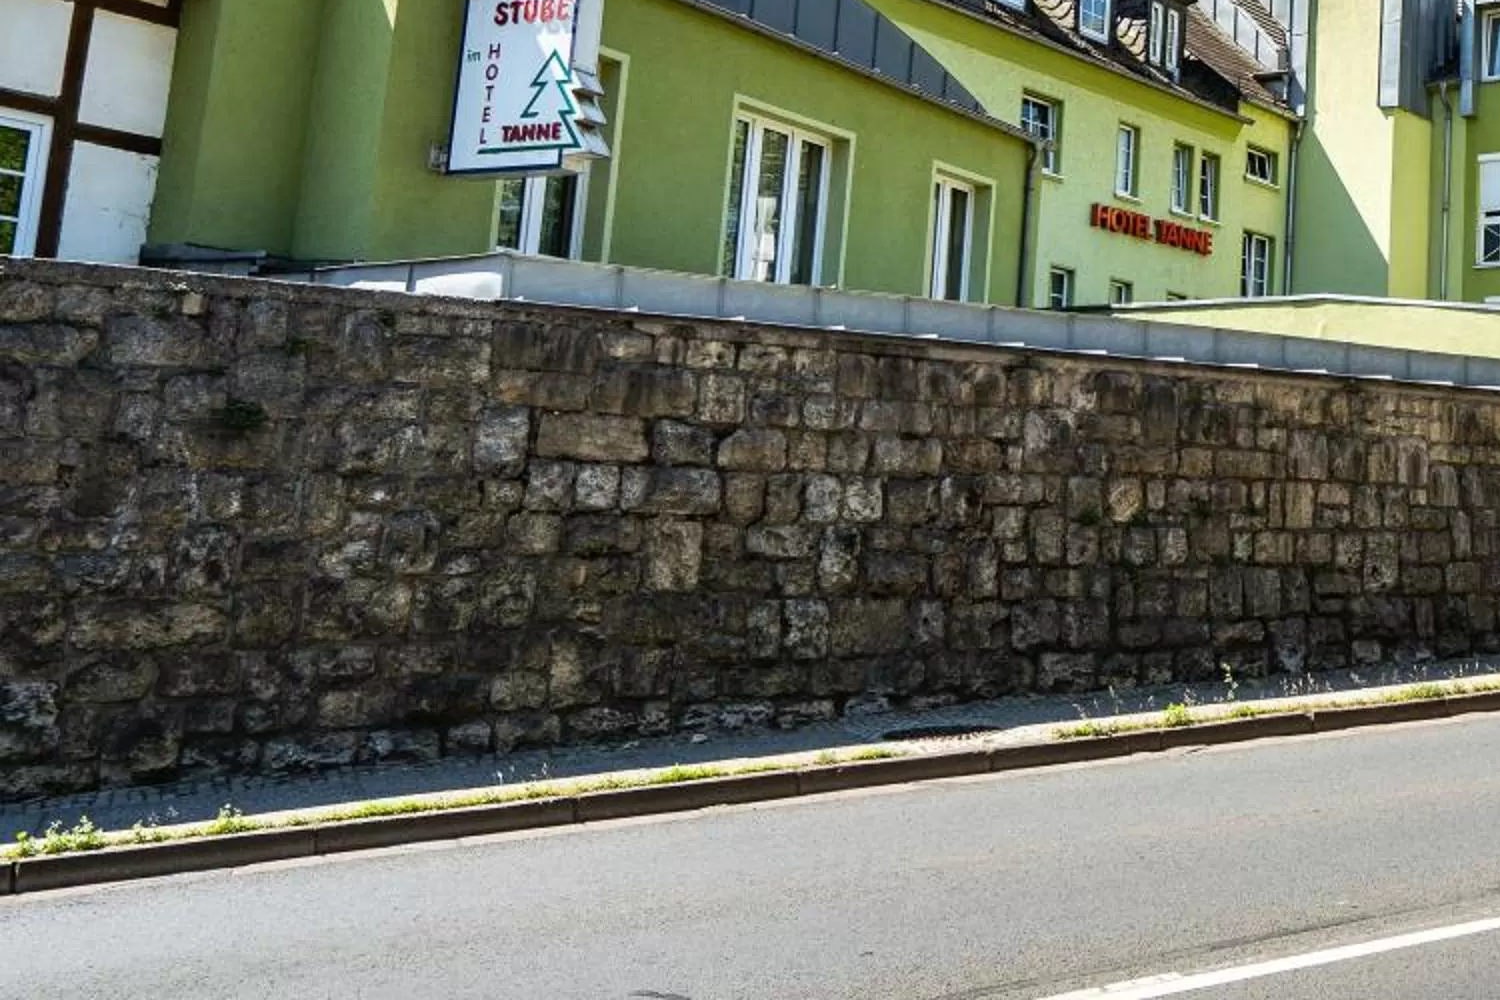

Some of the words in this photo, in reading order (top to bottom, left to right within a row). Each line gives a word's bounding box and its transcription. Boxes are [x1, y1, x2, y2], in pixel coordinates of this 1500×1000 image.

[480, 43, 502, 144] HOTEL
[502, 121, 562, 143] TANNE
[1090, 202, 1154, 240] HOTEL
[1154, 219, 1213, 256] TANNE
